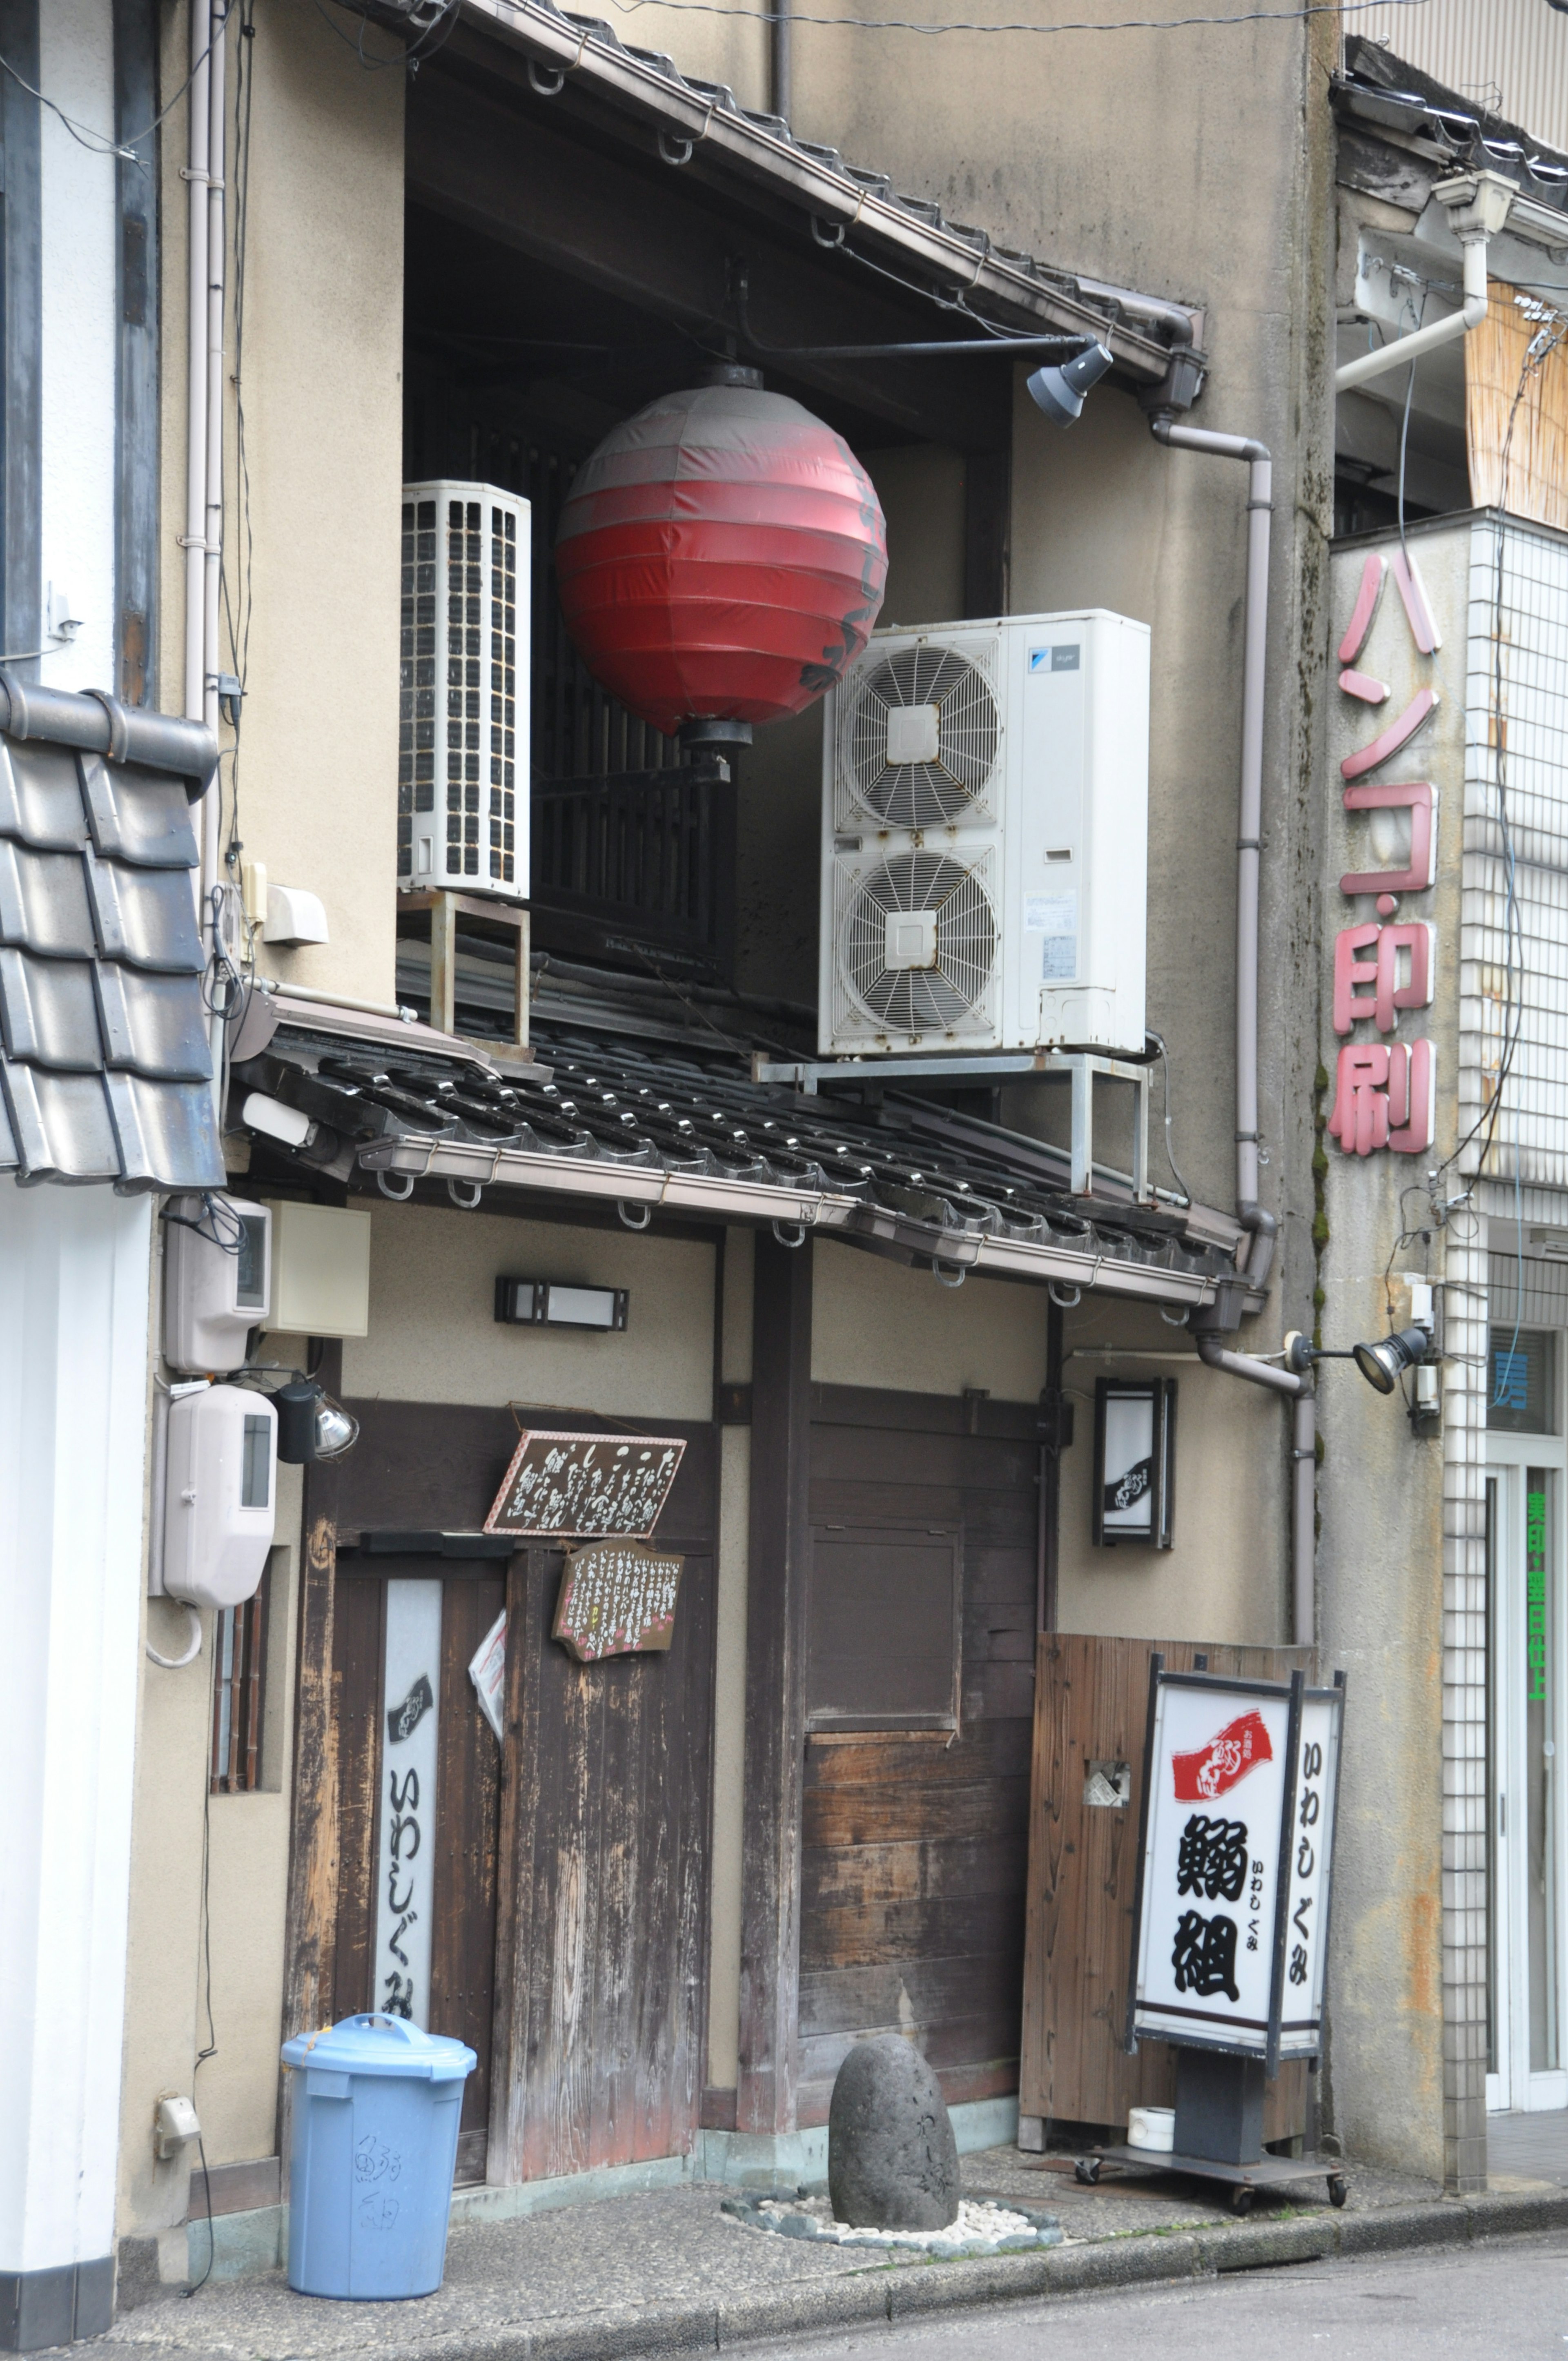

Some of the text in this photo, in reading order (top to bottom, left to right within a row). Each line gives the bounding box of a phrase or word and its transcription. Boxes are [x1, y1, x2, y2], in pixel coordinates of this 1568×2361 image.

[1329, 553, 1441, 1155] ハンコ・印刷
[1494, 1351, 1528, 1410] 房
[1242, 1730, 1253, 1759] お酒処
[381, 1766, 421, 2025] いわしぐみ
[1171, 1813, 1249, 2003] 鰯組
[1245, 1859, 1264, 1952] いわしぐみ
[1290, 1742, 1323, 1987] いわしぐみ
